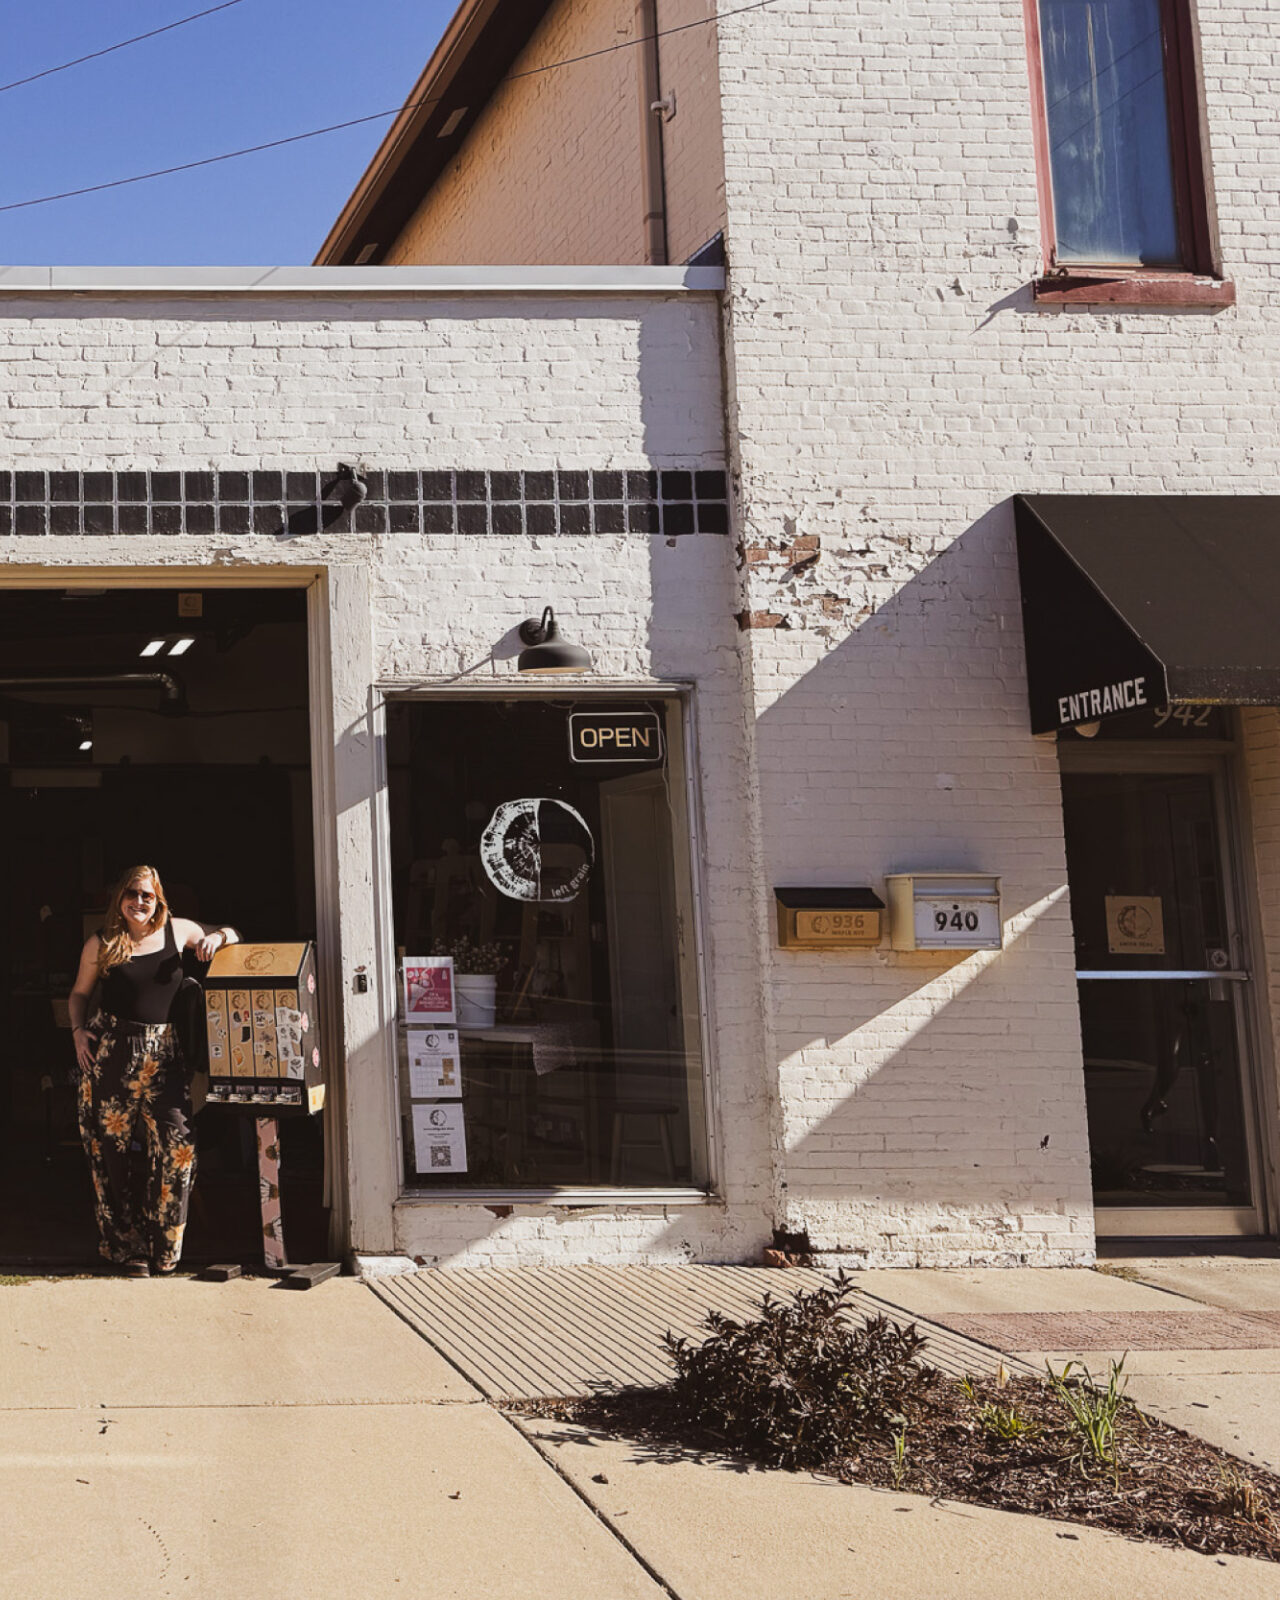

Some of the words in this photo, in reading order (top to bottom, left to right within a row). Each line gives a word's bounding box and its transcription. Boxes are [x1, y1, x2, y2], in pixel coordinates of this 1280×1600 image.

[1058, 677, 1147, 723] ENTRANCE
[580, 727, 650, 748] OPEN
[551, 884, 570, 898] left
[569, 863, 591, 890] grain
[832, 914, 864, 929] 936
[935, 911, 979, 931] 940
